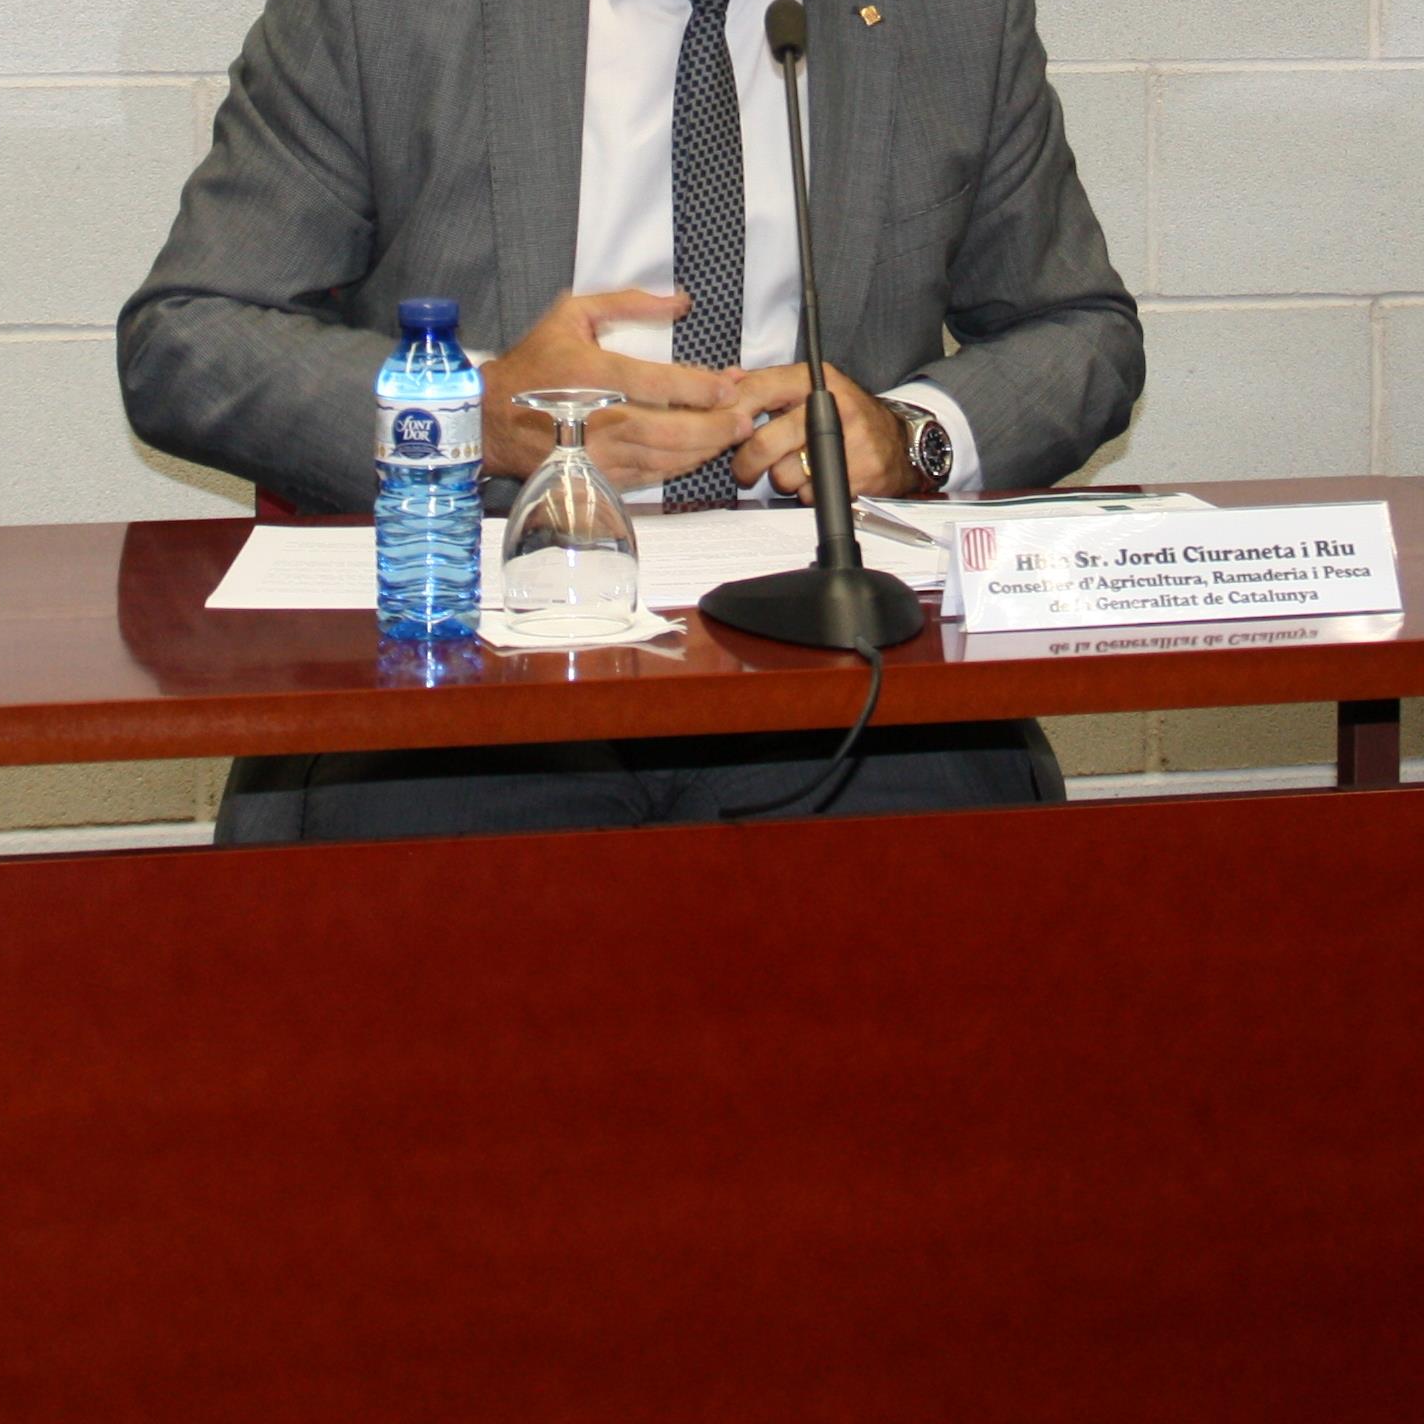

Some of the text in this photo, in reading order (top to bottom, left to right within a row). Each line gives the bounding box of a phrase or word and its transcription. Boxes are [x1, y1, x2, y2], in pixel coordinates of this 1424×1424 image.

[1074, 550, 1109, 569] Sr.
[1115, 547, 1177, 566] Jordi
[1183, 544, 1296, 563] Ciuraneta
[1300, 541, 1309, 558] i
[1314, 540, 1355, 557] Riu
[988, 579, 1073, 594] Conseler
[1212, 567, 1309, 584] Ramaderia
[1312, 567, 1318, 579] i
[1322, 565, 1372, 580] Pesca
[1096, 593, 1198, 610] Generalitat
[1203, 592, 1223, 605] de
[1228, 589, 1319, 604] Catalunya
